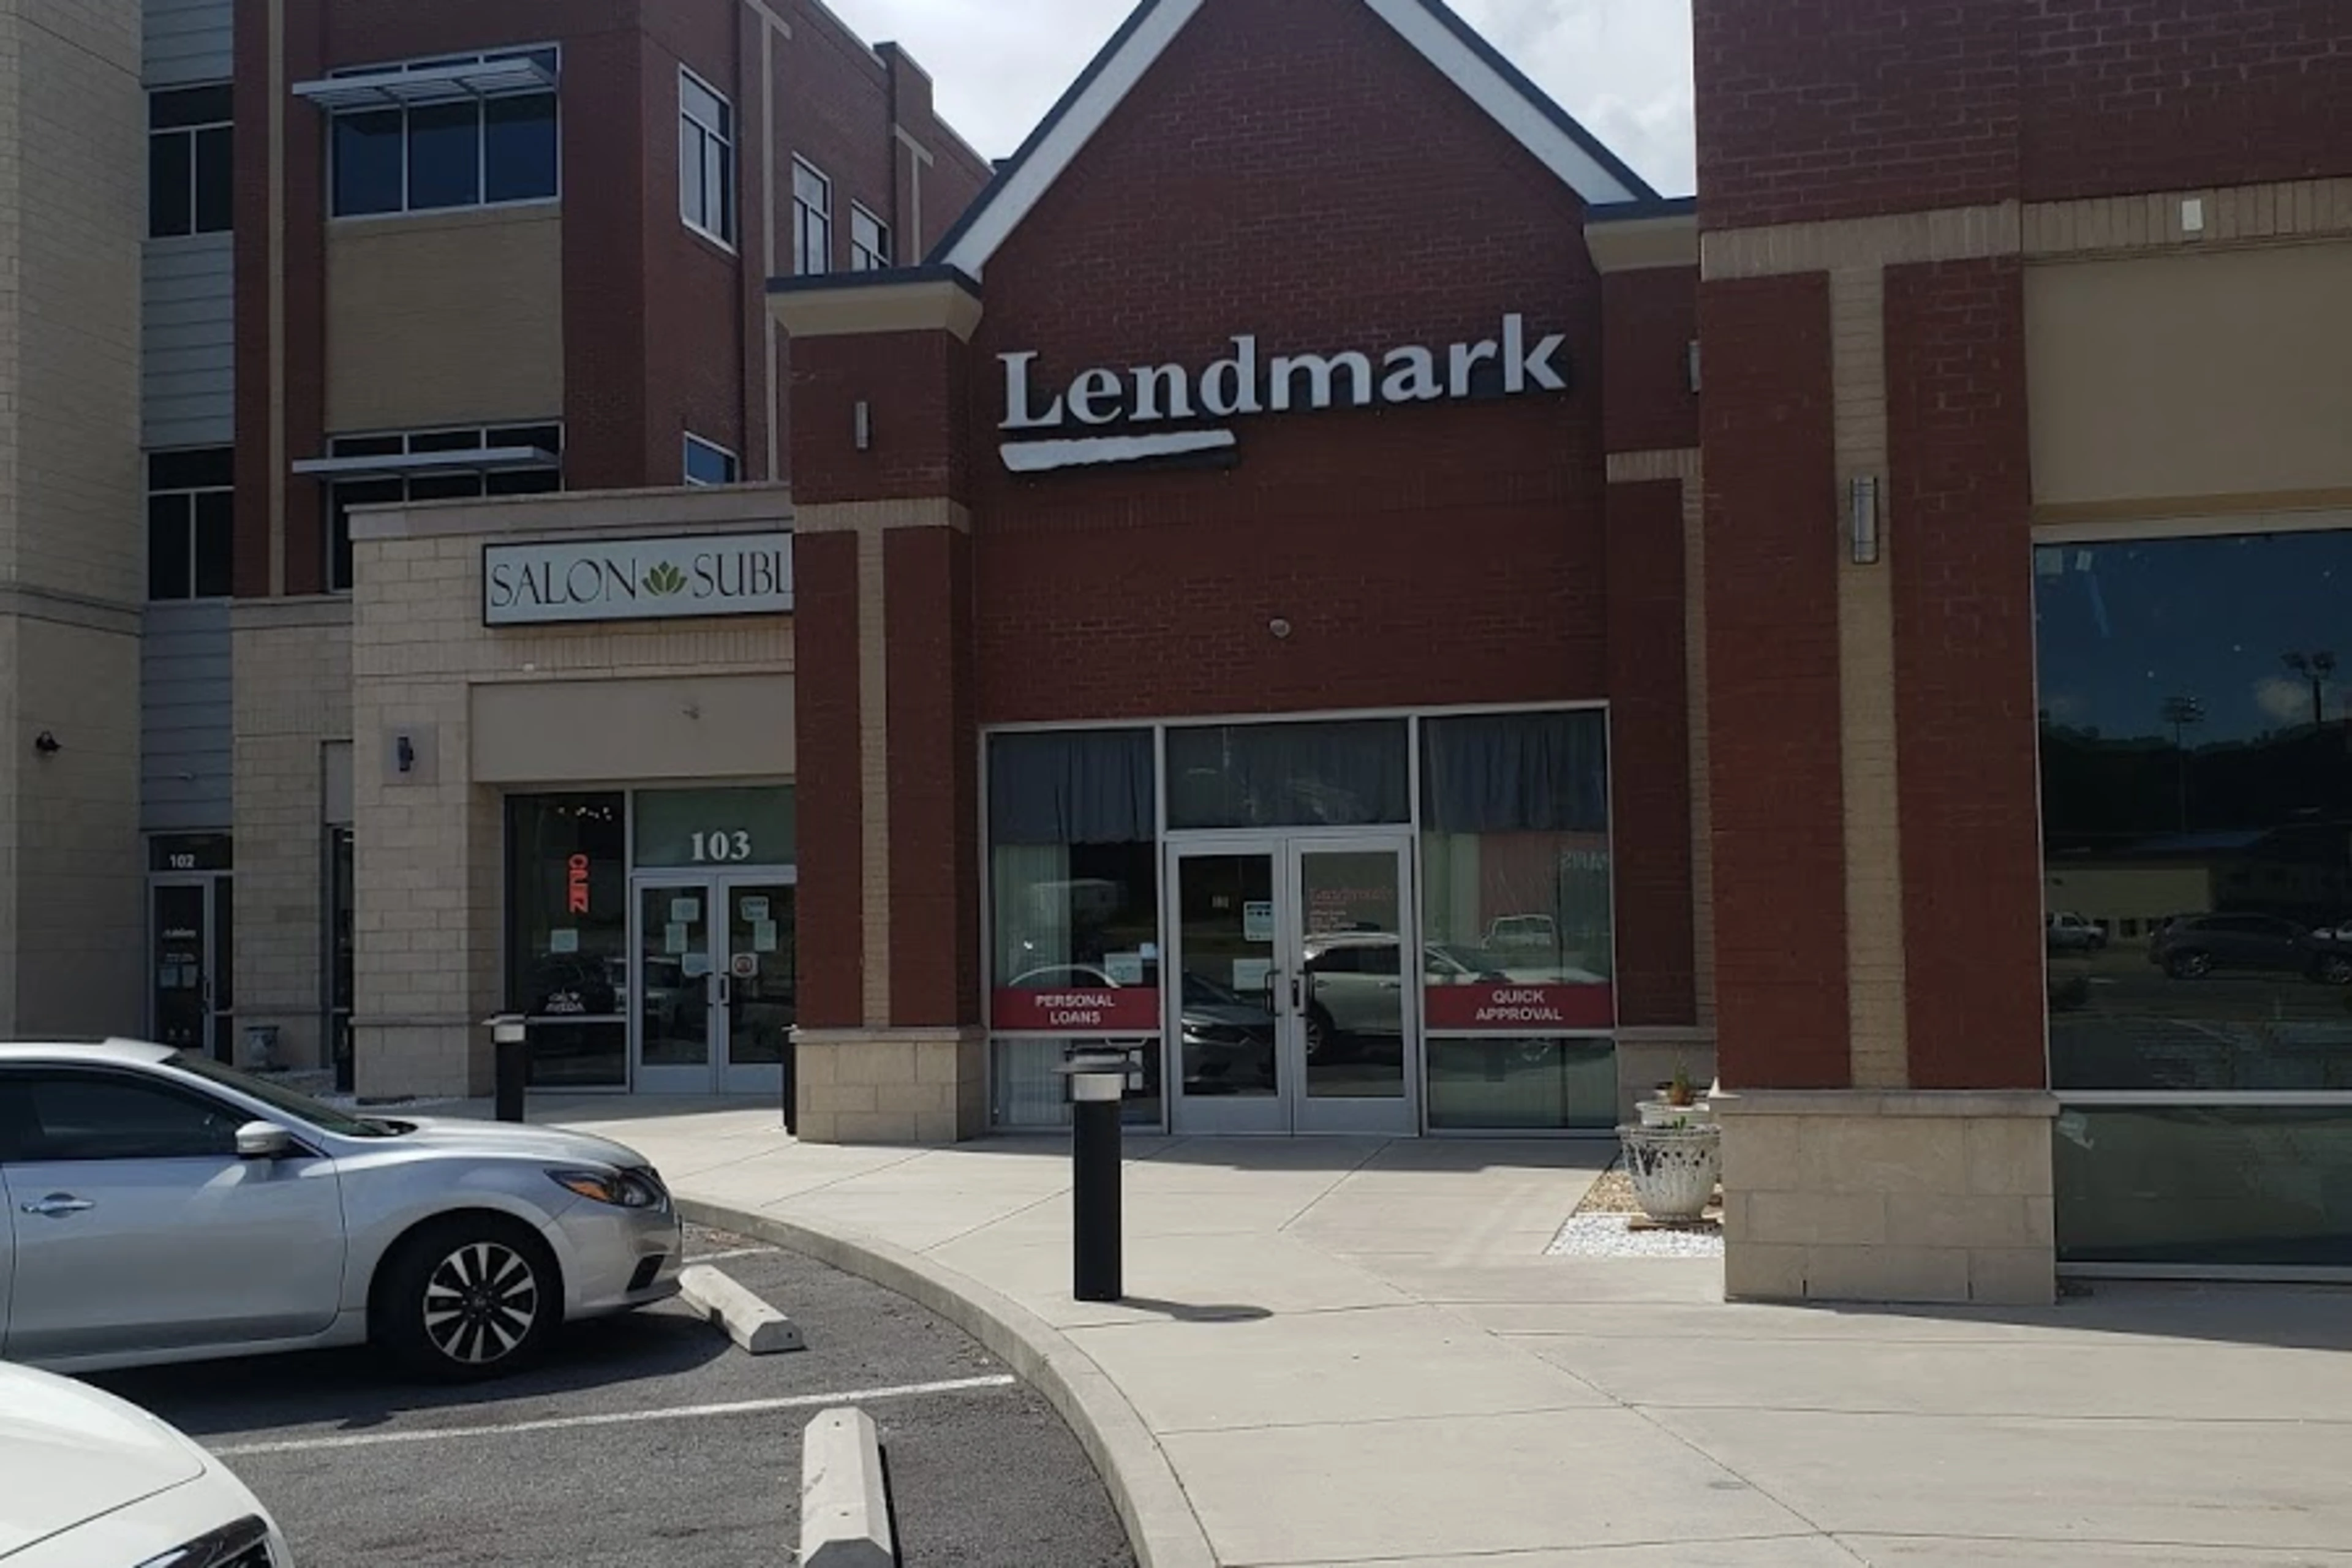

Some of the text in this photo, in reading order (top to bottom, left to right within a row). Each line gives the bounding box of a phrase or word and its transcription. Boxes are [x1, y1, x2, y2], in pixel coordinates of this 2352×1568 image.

[997, 312, 1566, 430] Lendmark
[491, 558, 636, 607] SALON
[692, 831, 750, 861] 103
[169, 854, 195, 868] 102
[1035, 994, 1115, 1008] PERSONAL
[1492, 989, 1545, 1003] QUICK
[1050, 1011, 1101, 1025] LOANS
[1476, 1008, 1563, 1020] APPROVAL
